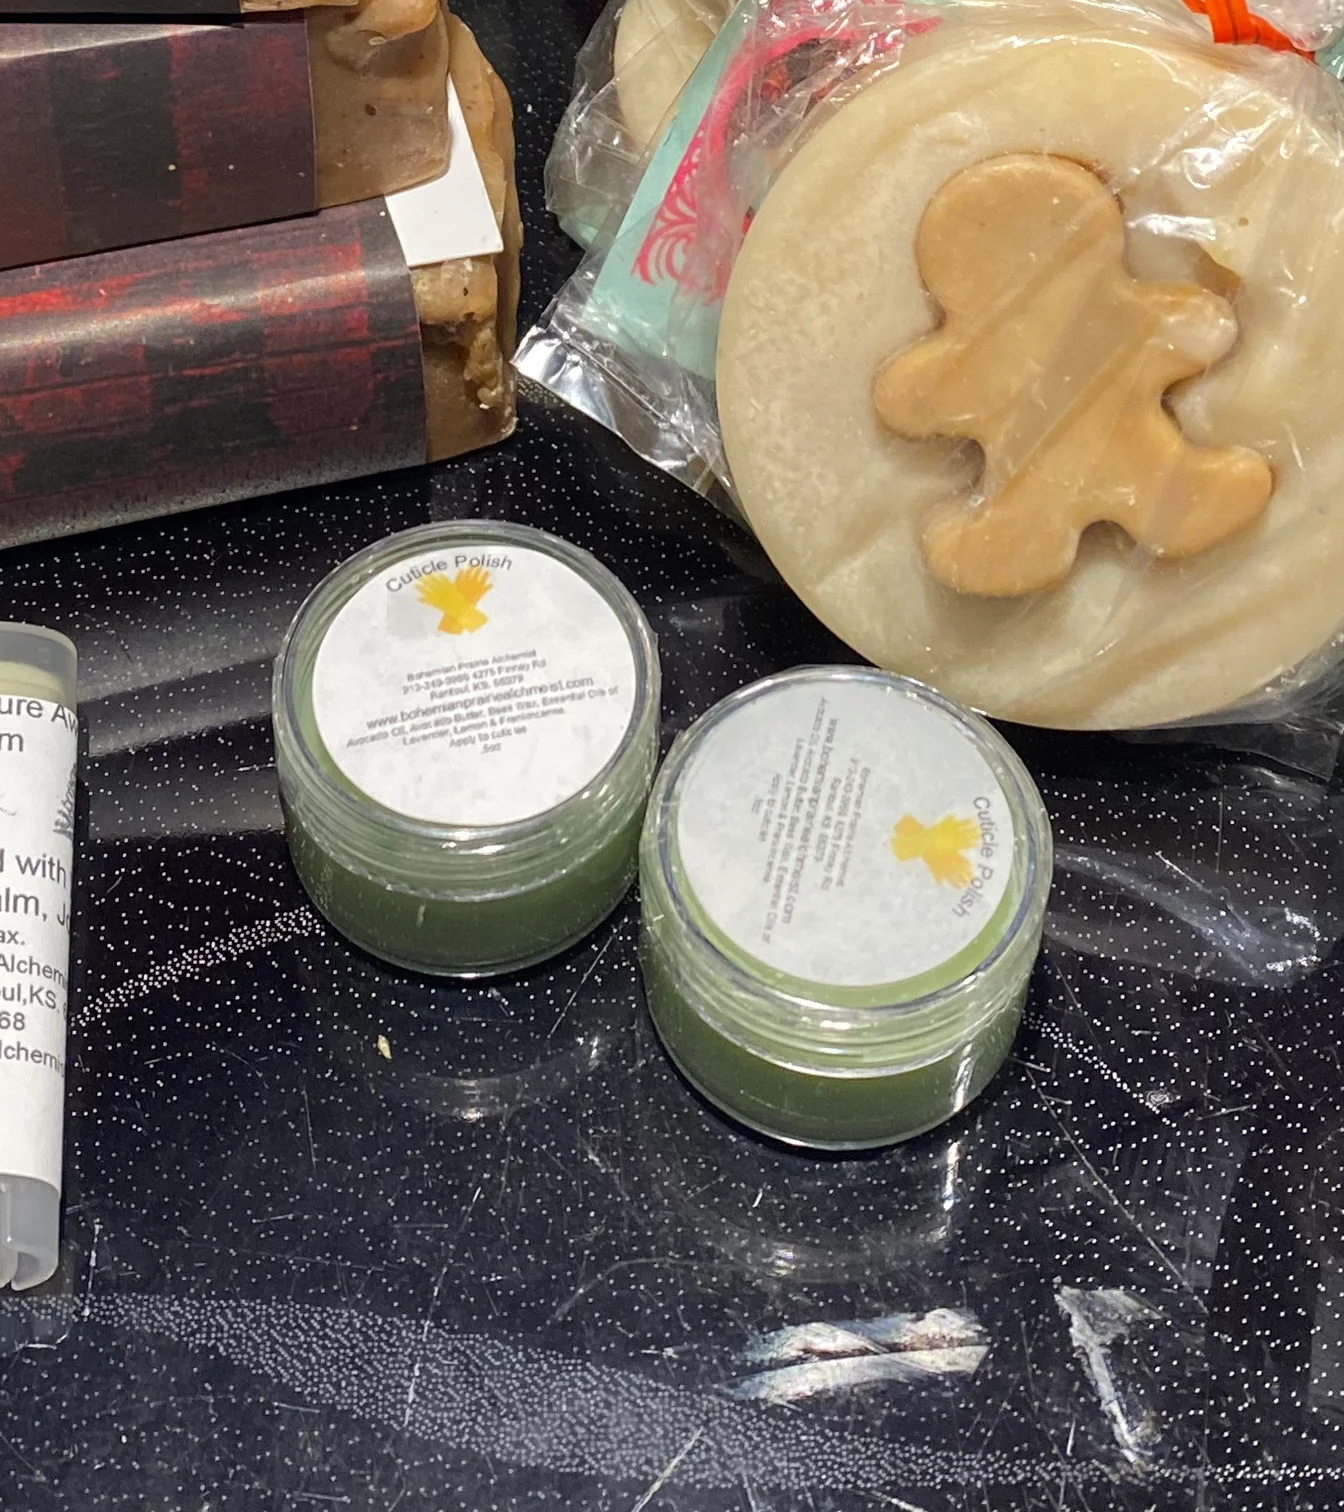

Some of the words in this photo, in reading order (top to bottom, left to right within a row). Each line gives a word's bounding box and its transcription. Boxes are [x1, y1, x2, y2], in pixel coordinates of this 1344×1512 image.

[385, 559, 449, 593] Cuticle
[454, 554, 513, 570] Polish
[973, 796, 999, 859] Cuticle
[14, 852, 68, 889] with
[951, 864, 994, 918] Polish
